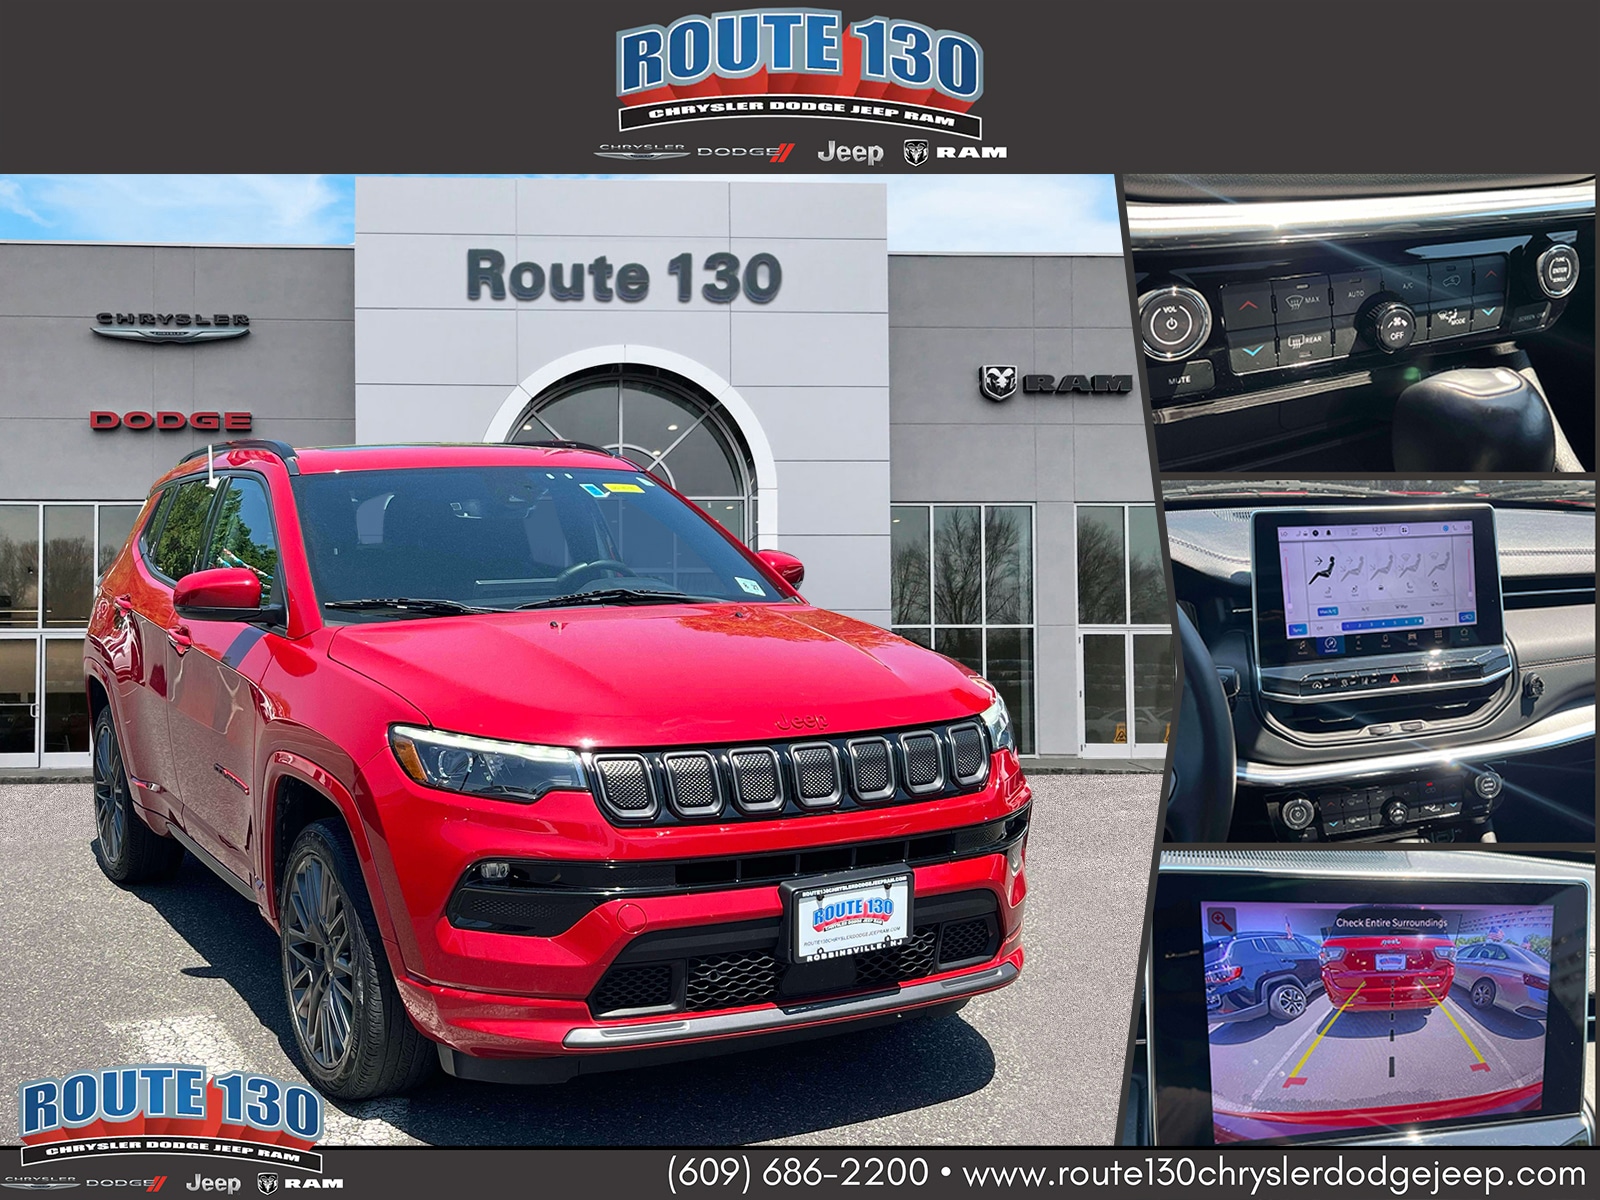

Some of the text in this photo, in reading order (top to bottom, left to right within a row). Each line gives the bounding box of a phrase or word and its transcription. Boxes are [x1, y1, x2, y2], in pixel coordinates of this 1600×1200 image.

[467, 248, 783, 305] Route 130
[1402, 282, 1414, 290] A/C
[1347, 289, 1365, 299] AUTO
[1304, 296, 1321, 304] MAX
[1163, 305, 1178, 314] VOL
[96, 313, 249, 326] CHRYSLER
[1305, 335, 1323, 343] REAR
[1390, 331, 1405, 341] OFF
[1022, 374, 1133, 394] RAM
[1168, 375, 1191, 385] MUTE
[89, 410, 252, 431] DODGE
[775, 713, 829, 731] Jeep
[814, 899, 864, 926] ROUTE
[866, 898, 893, 916] 130
[1336, 917, 1448, 930] Check Entire Surroundings
[890, 939, 904, 947] NJ
